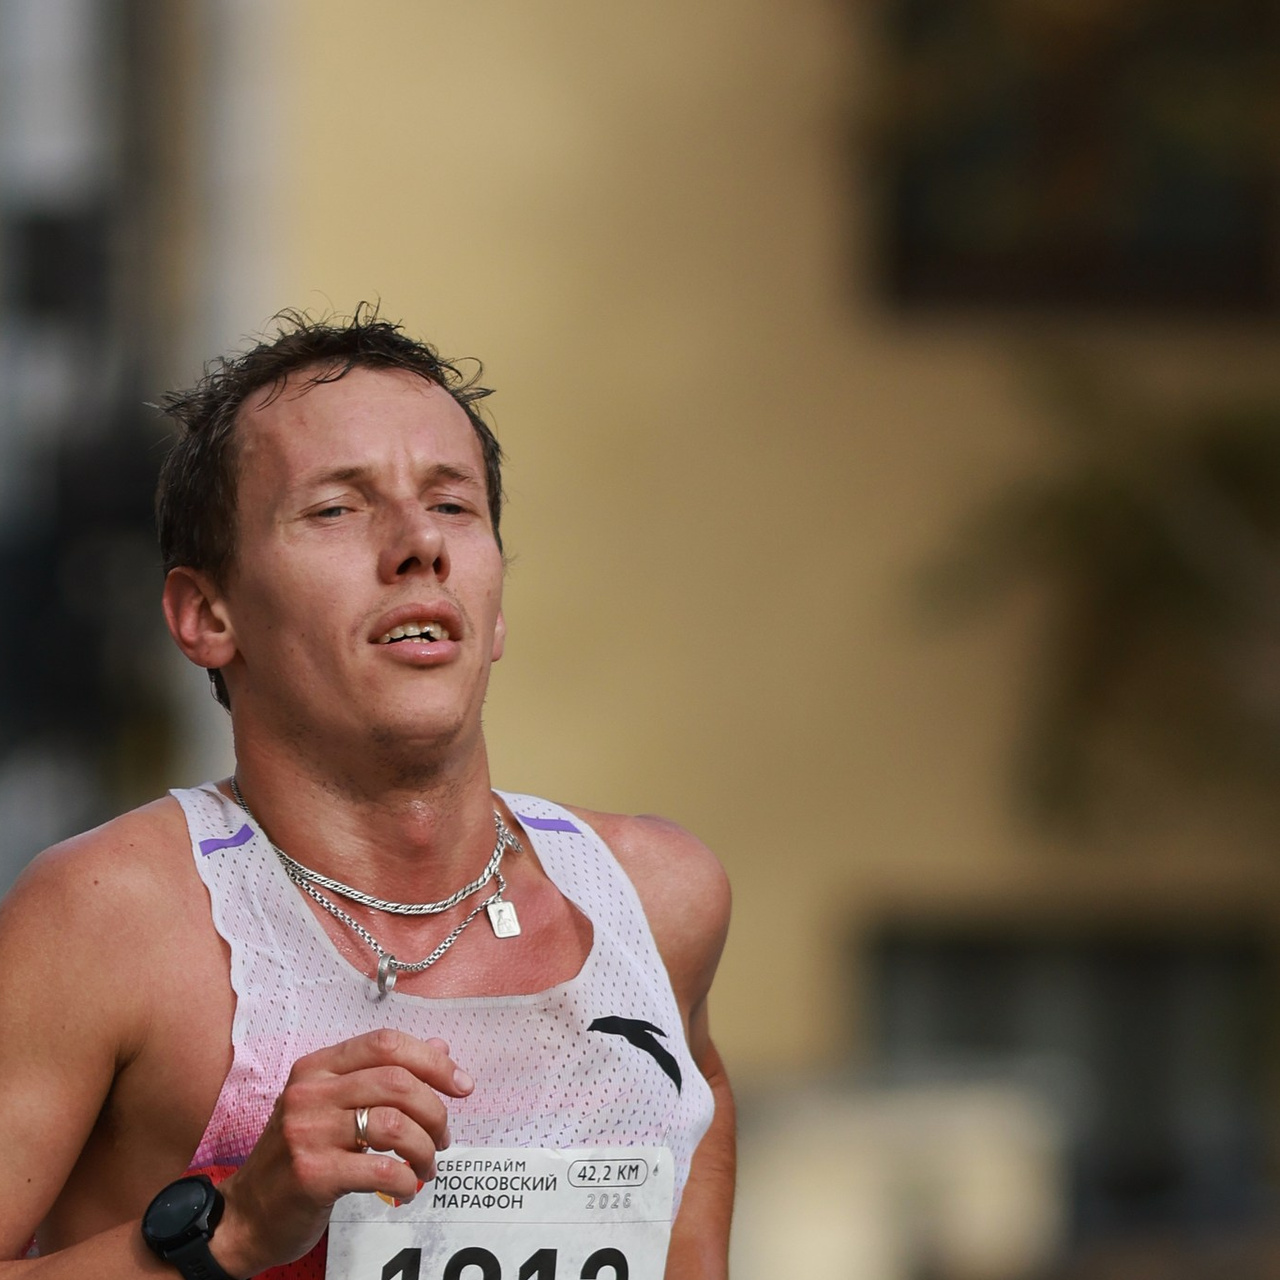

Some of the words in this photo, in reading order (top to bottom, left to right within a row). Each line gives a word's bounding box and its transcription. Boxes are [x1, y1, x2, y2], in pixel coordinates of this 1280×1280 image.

[436, 1158, 526, 1172] СБЕРПРАЙМ
[577, 1165, 612, 1183] 42,2
[434, 1173, 557, 1191] МОСКОВСКИЙ
[432, 1194, 524, 1209] МАРАФОН
[585, 1192, 632, 1210] 2026
